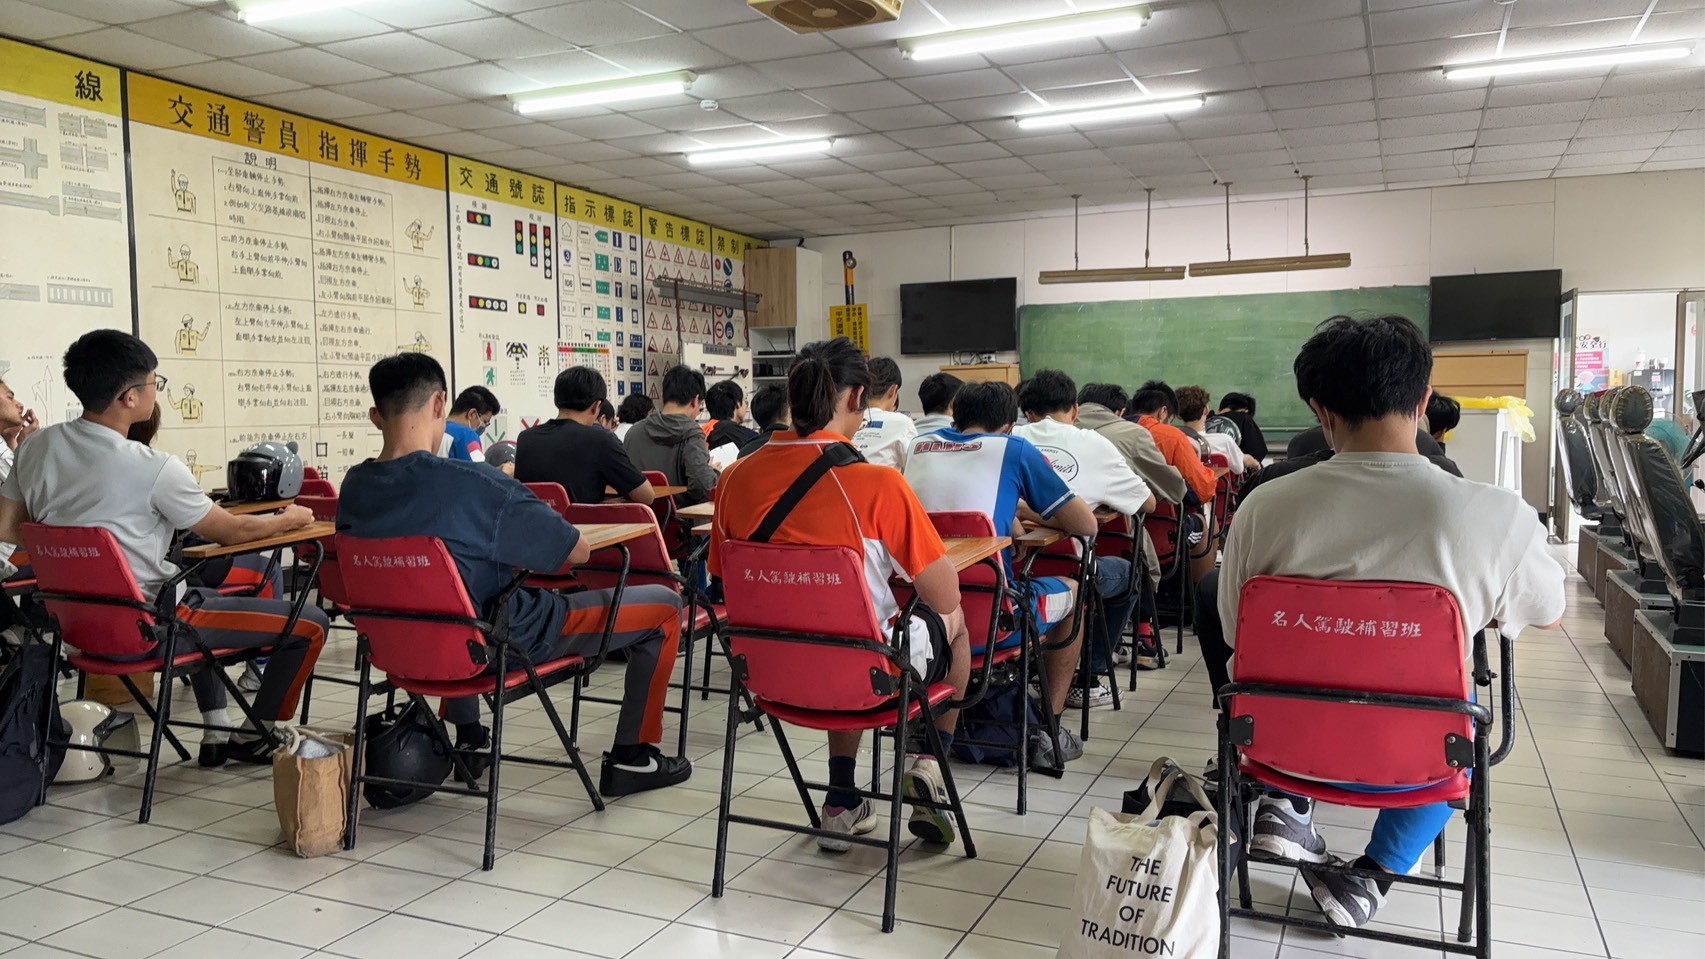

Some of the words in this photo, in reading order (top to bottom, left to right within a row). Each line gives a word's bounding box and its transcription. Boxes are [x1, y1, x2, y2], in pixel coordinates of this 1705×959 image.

[74, 70, 104, 102] 線
[168, 94, 421, 181] 交通警員指揮手勢
[459, 166, 545, 206] 交通號誌
[564, 195, 634, 228] 指示標誌
[648, 216, 705, 246] 警告標誌
[743, 568, 842, 586] 名人駕駛補習班
[1271, 610, 1422, 638] 名人駕駛補習班
[1130, 856, 1161, 876] THE
[1106, 875, 1172, 903] FUTURE
[1119, 905, 1145, 924] OF
[1081, 919, 1175, 957] TRADITION
